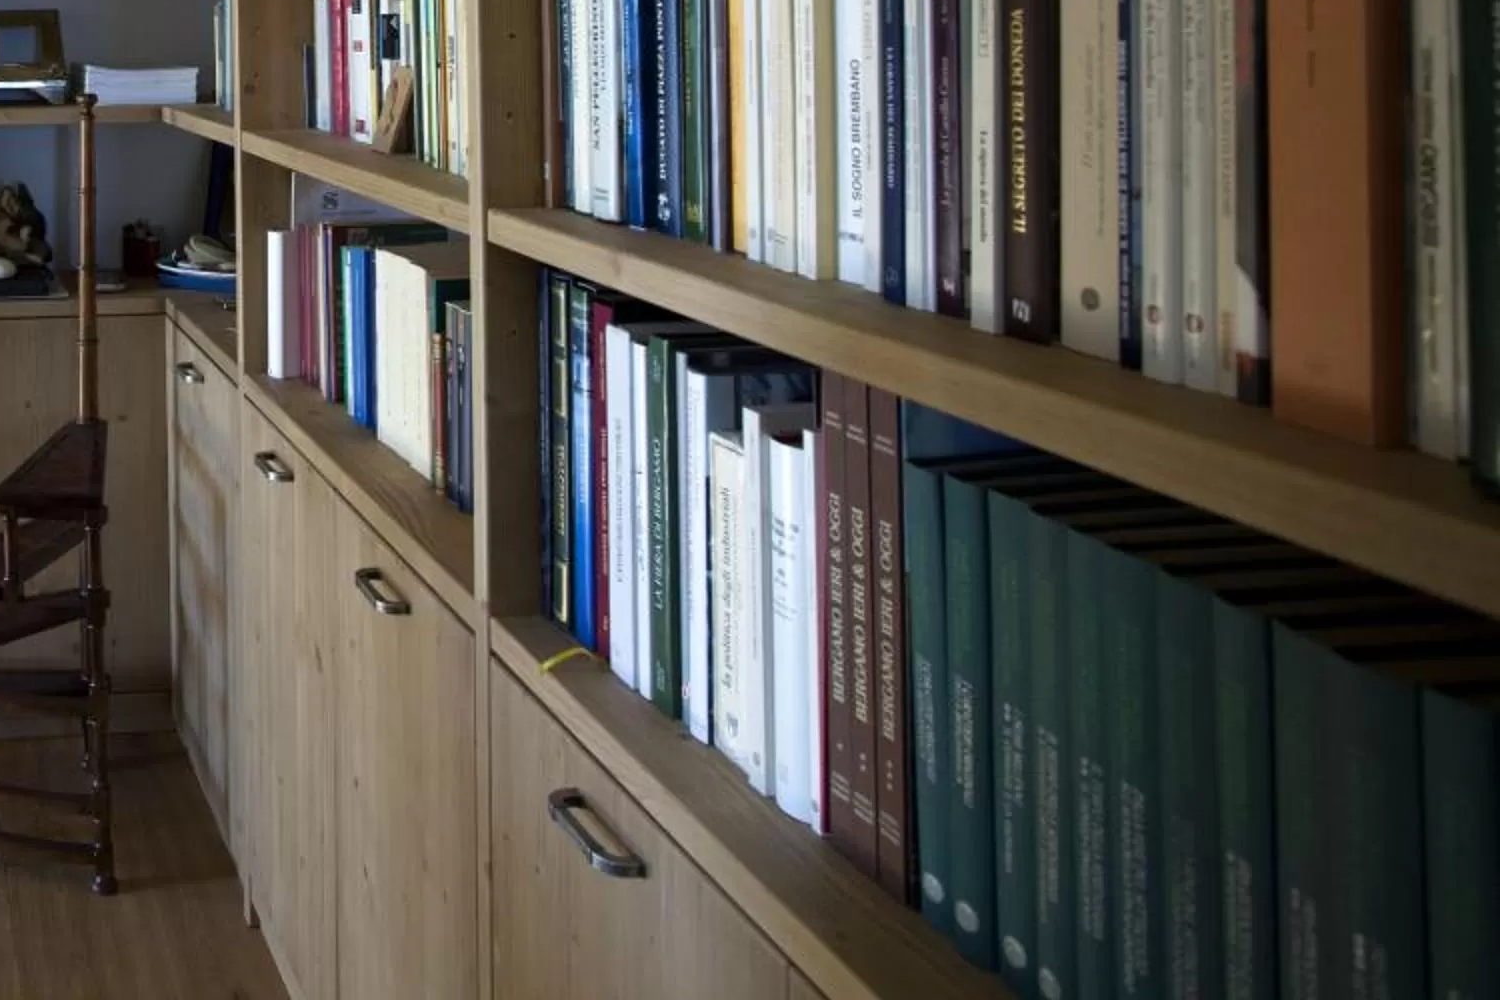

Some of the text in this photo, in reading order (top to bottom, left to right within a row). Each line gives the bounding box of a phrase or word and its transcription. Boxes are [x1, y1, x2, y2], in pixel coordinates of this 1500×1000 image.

[657, 43, 665, 95] PIAZZA
[1009, 8, 1027, 233] IL SEGRETO DEI DONEDA
[591, 115, 600, 150] SAN
[659, 118, 667, 180] DUCATO
[850, 59, 861, 217] IL SOGNO BREMBANO
[652, 437, 663, 610] LA FIERA DI BERGAMO
[720, 487, 731, 567] industriali
[721, 571, 732, 608] degli
[723, 612, 733, 669] politica
[830, 492, 844, 703] BERGAMO IERI & OGGI
[852, 507, 868, 723] BERGAMO IERI & OGGI
[880, 520, 895, 741] BERGAMO IERI & OGGI
